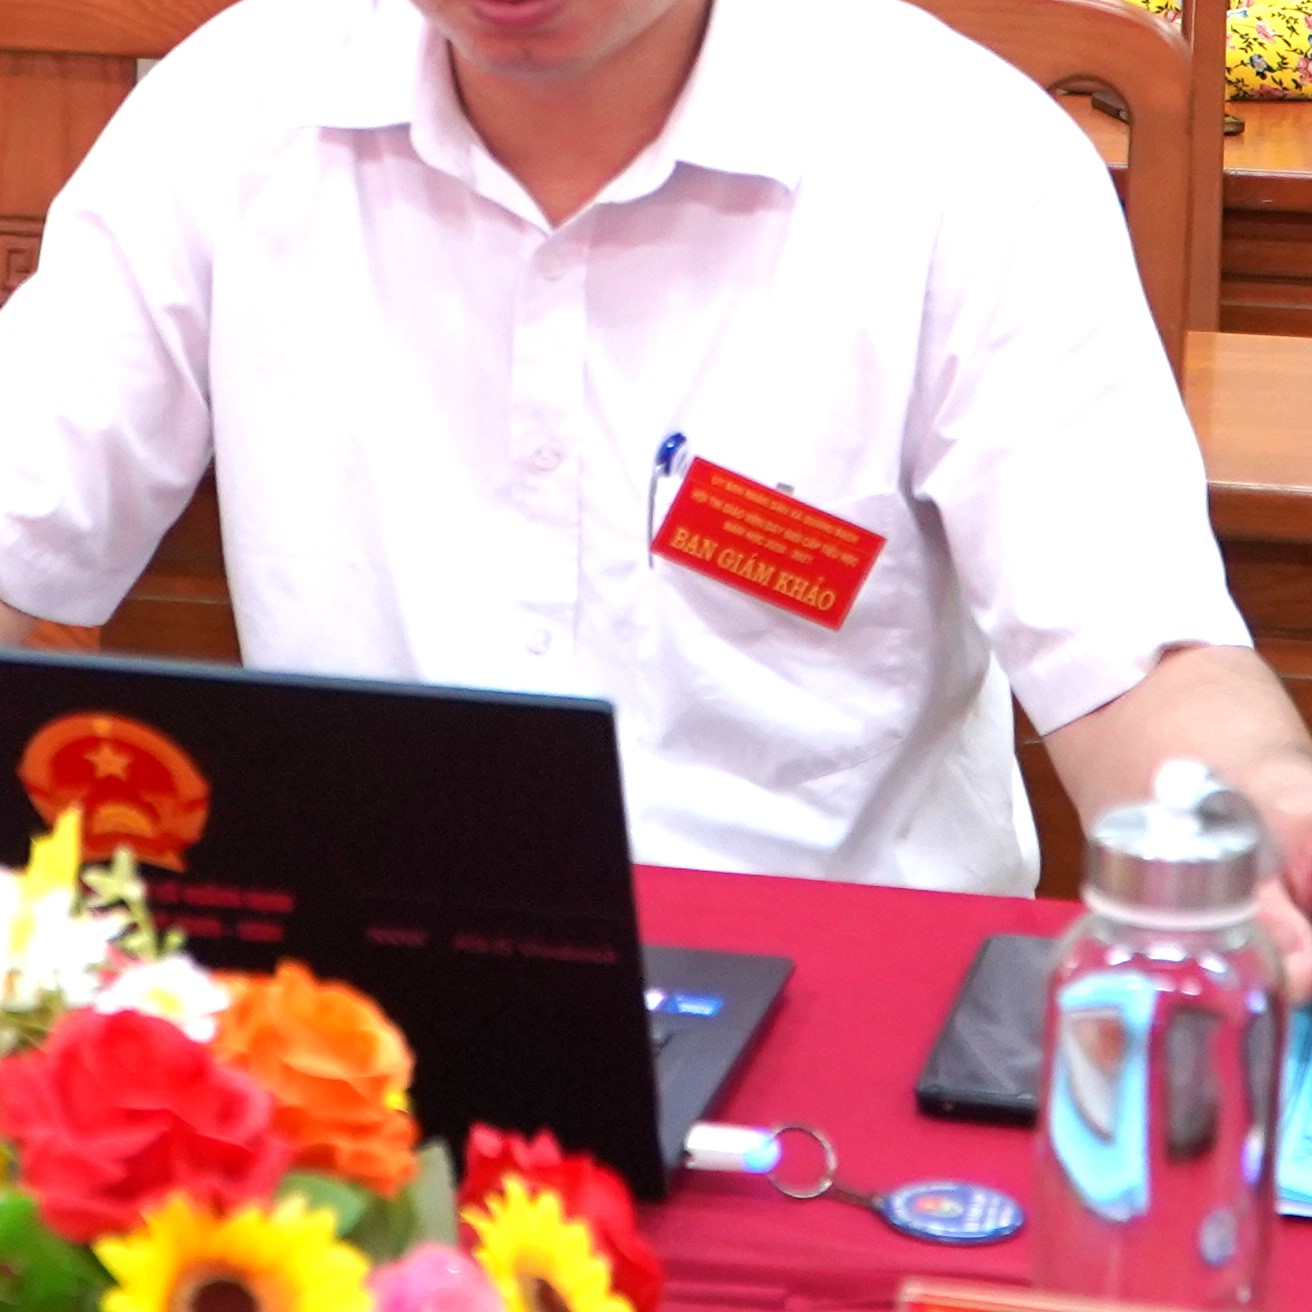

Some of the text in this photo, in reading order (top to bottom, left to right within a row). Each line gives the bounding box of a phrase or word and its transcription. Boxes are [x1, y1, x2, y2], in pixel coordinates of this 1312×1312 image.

[669, 527, 719, 562] BAN
[717, 547, 776, 587] GIÁM
[773, 571, 836, 612] KHẢO
